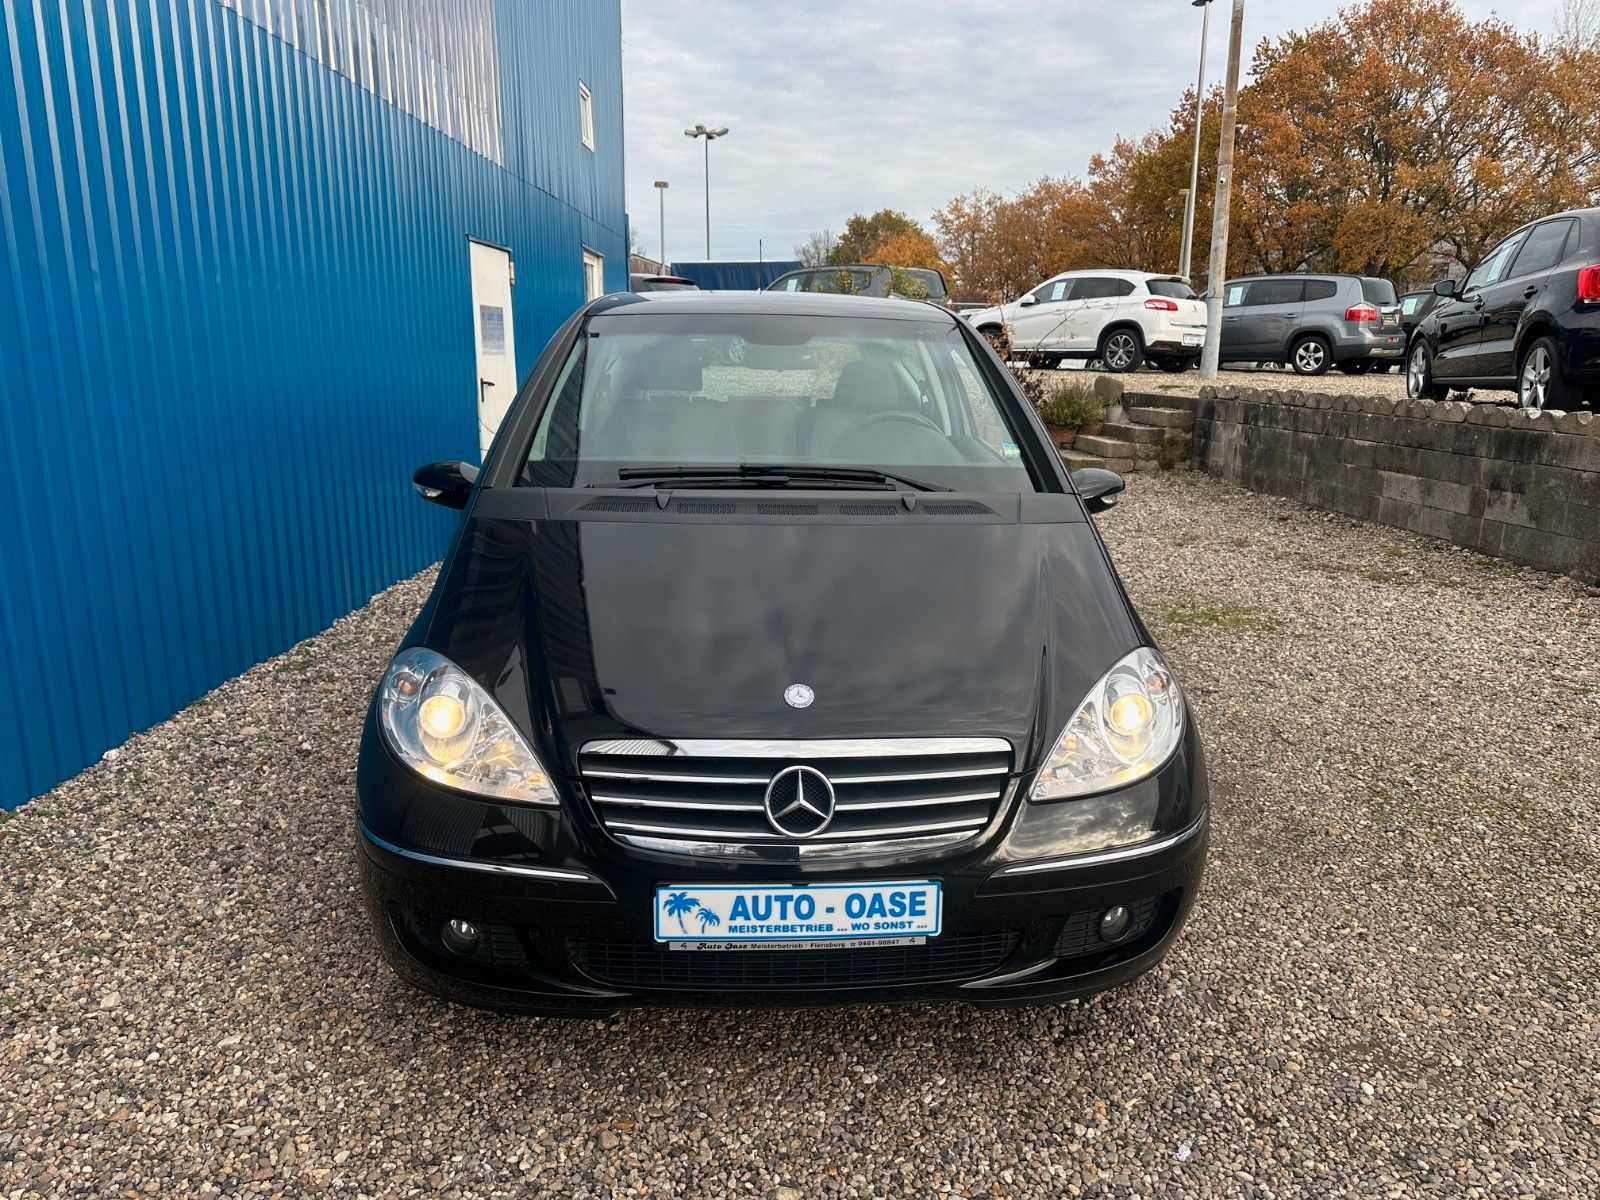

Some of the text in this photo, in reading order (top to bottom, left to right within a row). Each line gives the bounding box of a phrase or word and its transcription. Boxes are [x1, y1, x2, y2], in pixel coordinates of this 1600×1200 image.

[728, 894, 816, 921] AUTO
[845, 891, 927, 919] OASE
[728, 923, 834, 934] MEISTERBETRIEB
[851, 922, 870, 931] WO
[874, 920, 914, 931] SONST
[696, 942, 722, 950] Auto
[724, 942, 749, 950] Oase
[750, 941, 804, 949] Meisterbetrieb
[810, 941, 846, 949] Flensburg
